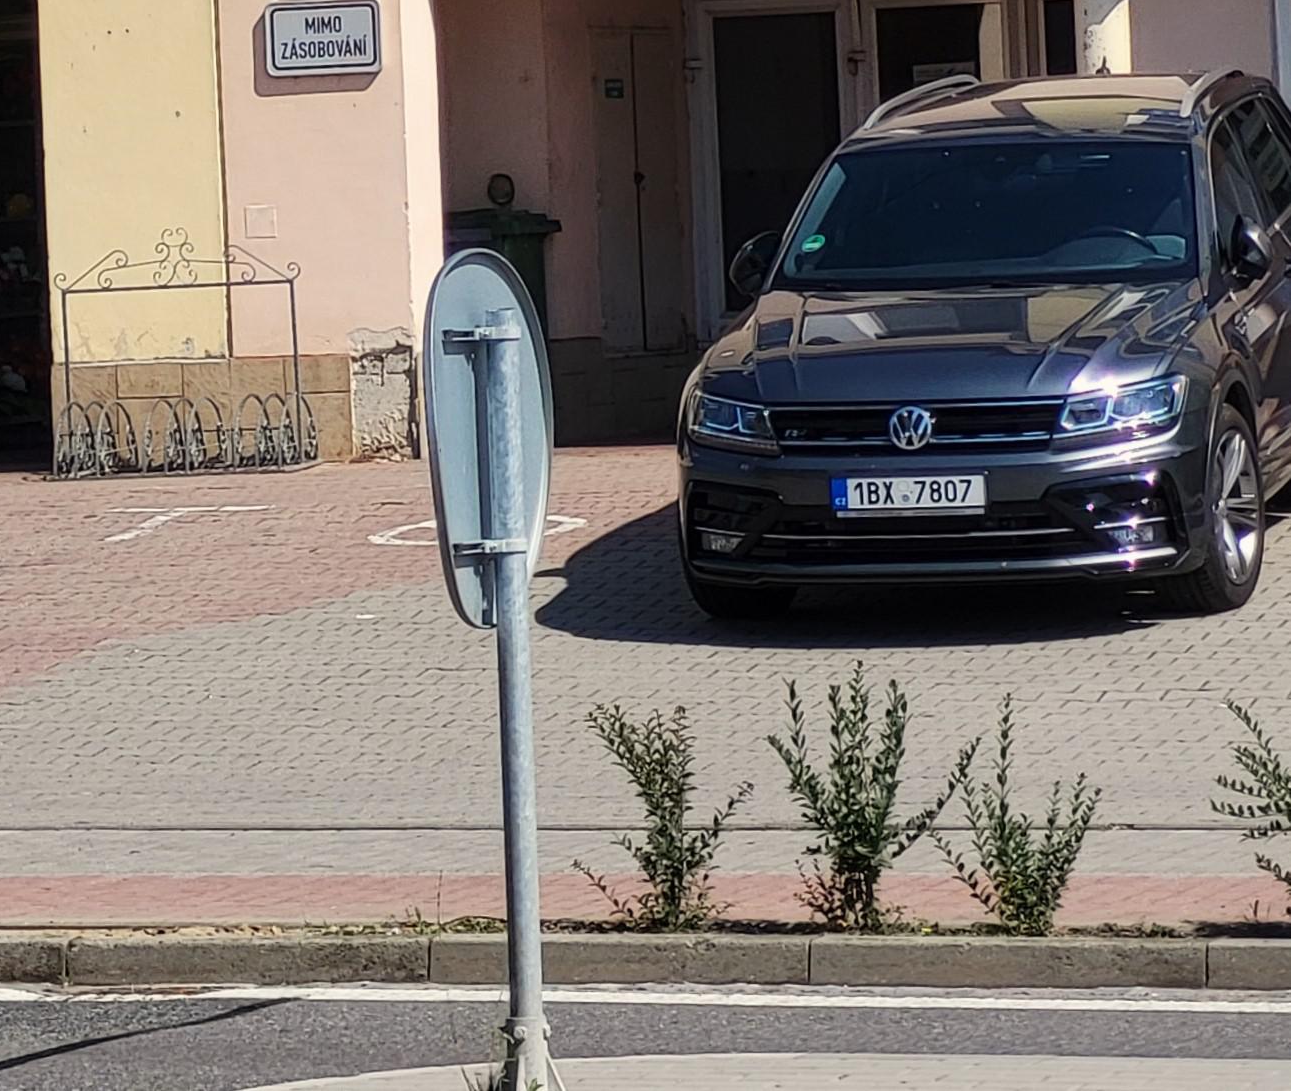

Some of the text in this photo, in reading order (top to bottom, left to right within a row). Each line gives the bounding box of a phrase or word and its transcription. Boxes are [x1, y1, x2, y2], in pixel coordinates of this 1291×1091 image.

[305, 15, 342, 35] MIMO
[281, 34, 367, 61] ZÁSOBOVÁNÍ
[853, 480, 895, 506] 1BX
[913, 479, 972, 504] 7807
